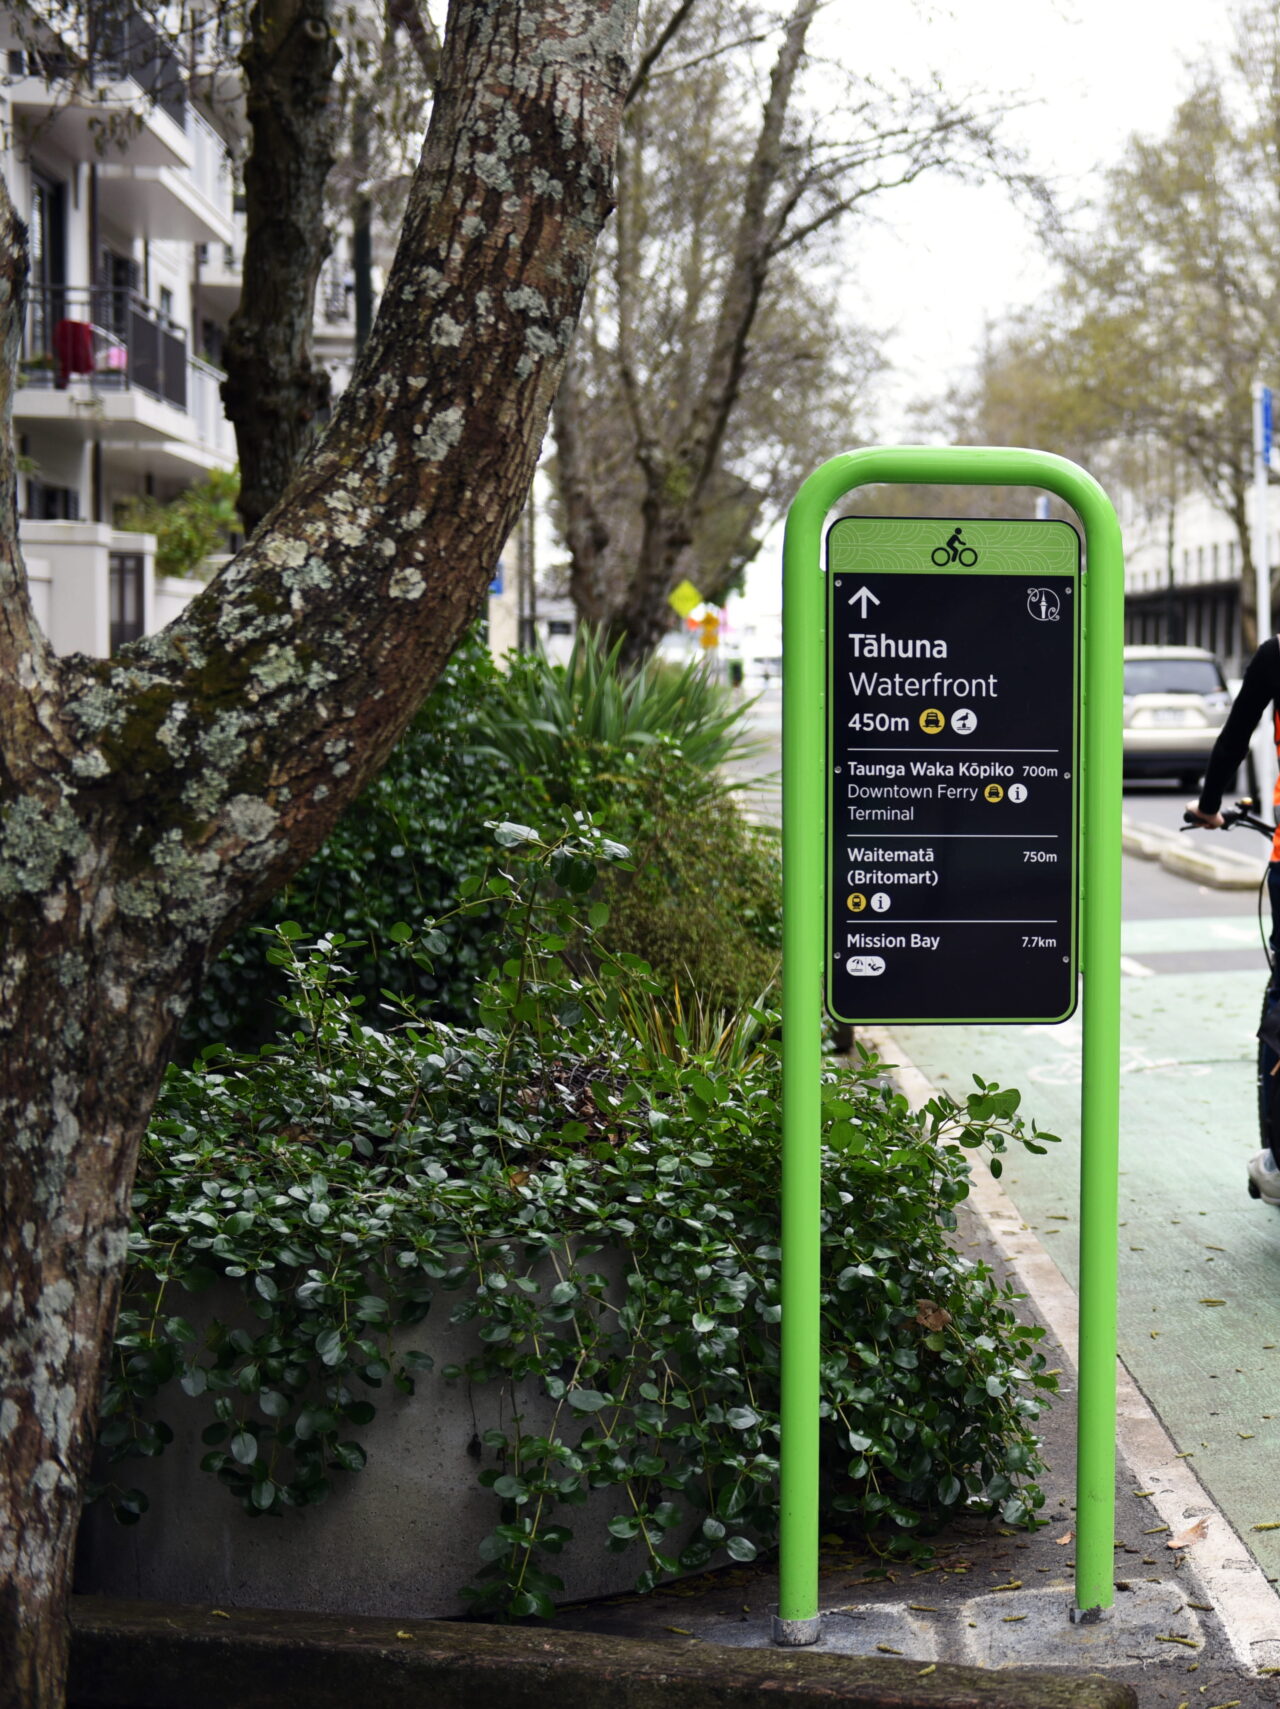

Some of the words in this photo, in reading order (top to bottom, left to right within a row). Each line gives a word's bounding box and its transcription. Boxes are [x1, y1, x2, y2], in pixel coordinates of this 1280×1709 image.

[848, 632, 948, 659] Tāhuna
[848, 671, 998, 698] Waterfront
[847, 712, 910, 732] 450m
[847, 761, 906, 779] Taunga
[909, 761, 954, 777] Waka
[958, 761, 1015, 780] Kōpiko
[1022, 765, 1058, 777] 700m
[847, 783, 933, 799] Downtown
[937, 784, 979, 802] Ferry
[847, 806, 914, 821] Terminal
[847, 847, 935, 863] Waitematā
[1022, 851, 1058, 863] 750m
[847, 869, 939, 887] (Britomart)
[847, 933, 906, 948] Mission
[910, 933, 941, 951] Bay
[1021, 936, 1057, 948] 7.7km
